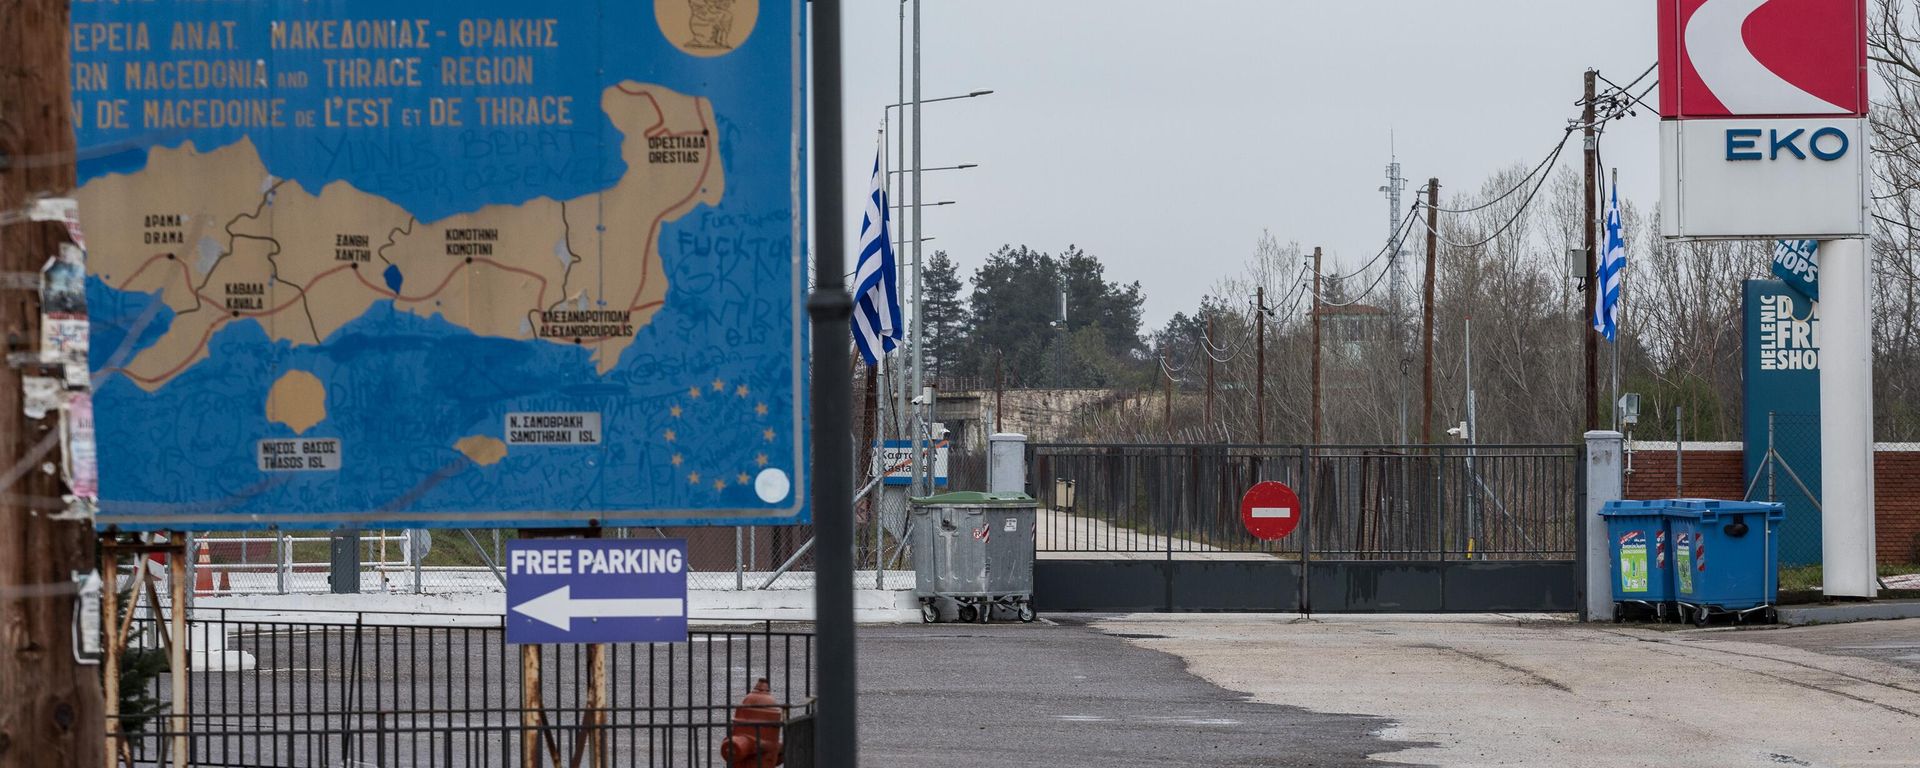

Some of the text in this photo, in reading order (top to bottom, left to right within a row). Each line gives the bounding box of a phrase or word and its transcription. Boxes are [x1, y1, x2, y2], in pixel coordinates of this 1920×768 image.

[74, 22, 150, 51] ΕΡΕΙΑ
[459, 18, 559, 48] ΘΡΑΚΗΣ
[126, 60, 268, 90] MACEDONIA
[278, 71, 308, 88] AND
[323, 57, 422, 88] THRACE
[442, 55, 533, 86] REGION
[97, 99, 129, 129] DE
[144, 98, 286, 129] MACEDOINE
[295, 110, 316, 128] DE
[402, 109, 421, 126] ET
[430, 97, 463, 127] DE
[476, 95, 573, 126] THRACE
[1725, 126, 1850, 161] EKO
[648, 151, 700, 164] ORESTIAS
[144, 231, 185, 245] DRAMA
[335, 248, 371, 262] XANTHI
[446, 243, 493, 256] KOMOTINI
[1774, 242, 1818, 283] HOPS
[226, 297, 263, 310] KAVALA
[1760, 295, 1776, 370] HELLENIC
[1777, 349, 1820, 370] SHO
[510, 430, 596, 443] SAMOTHRAKI ISL
[264, 454, 326, 469] THASOS ISL
[511, 549, 683, 575] FREE PARKING
